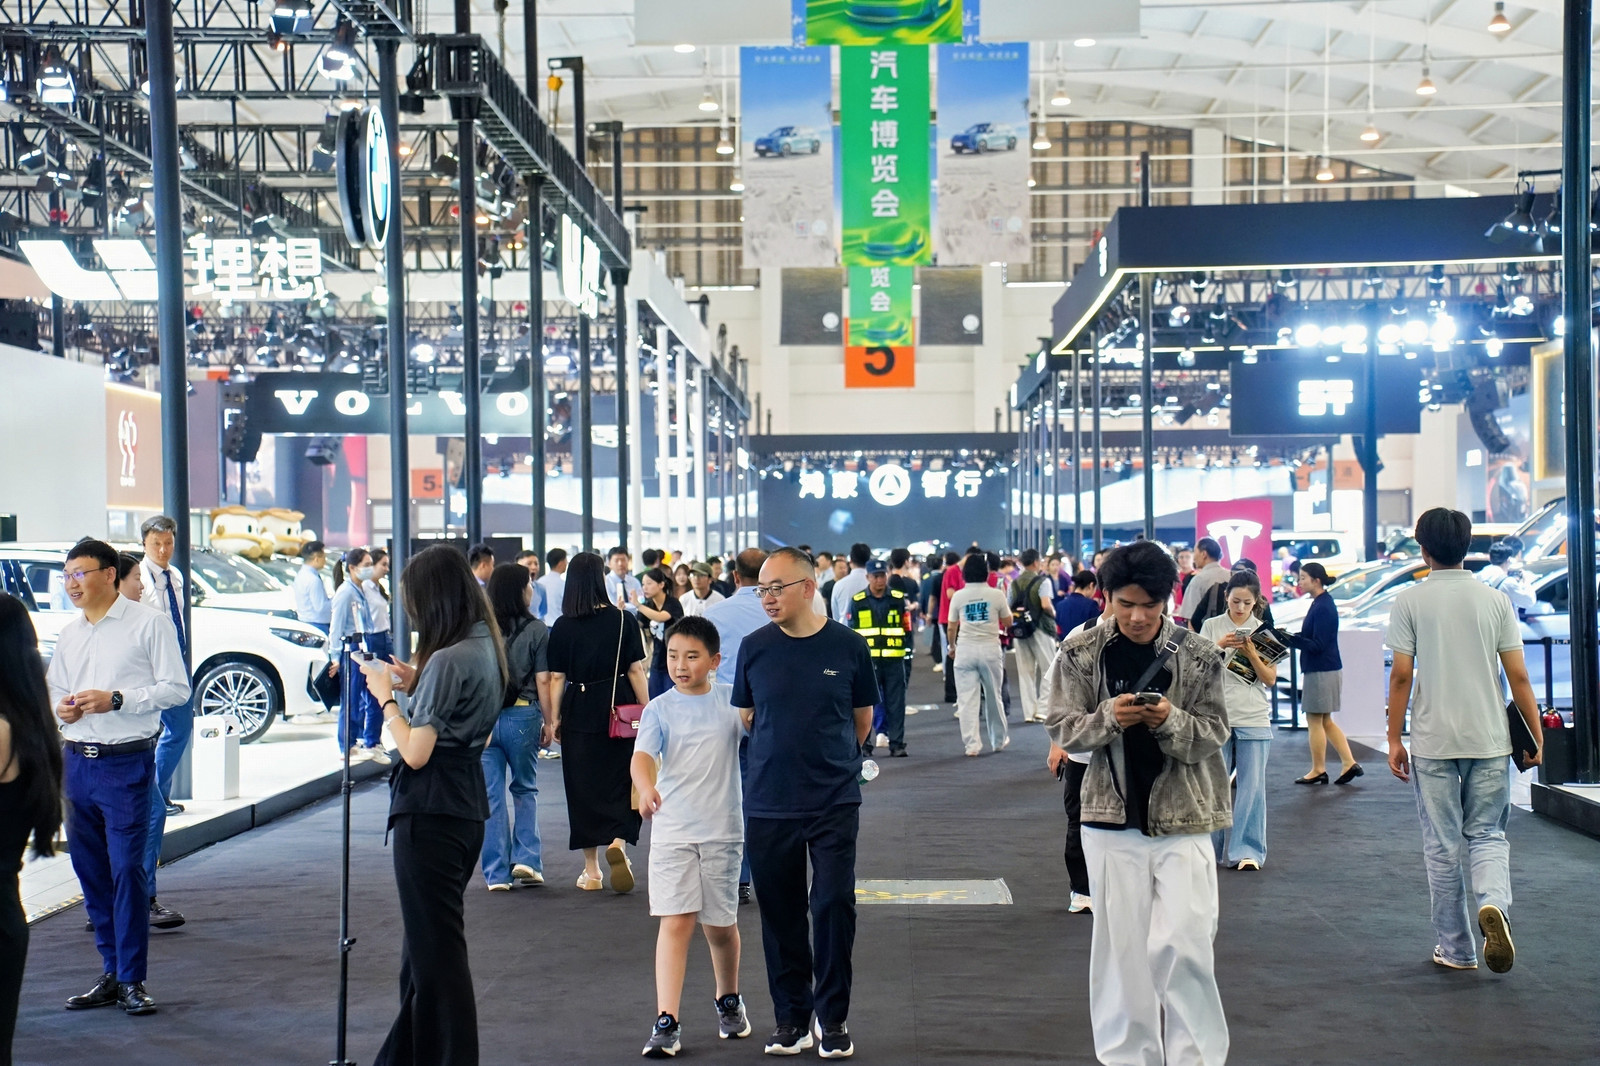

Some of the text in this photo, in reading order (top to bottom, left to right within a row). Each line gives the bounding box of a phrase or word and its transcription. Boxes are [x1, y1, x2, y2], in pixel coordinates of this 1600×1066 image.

[869, 50, 900, 218] 汽车博览会
[191, 236, 327, 301] 理想
[870, 266, 892, 312] 览会
[864, 346, 895, 376] 5
[423, 474, 436, 491] 5
